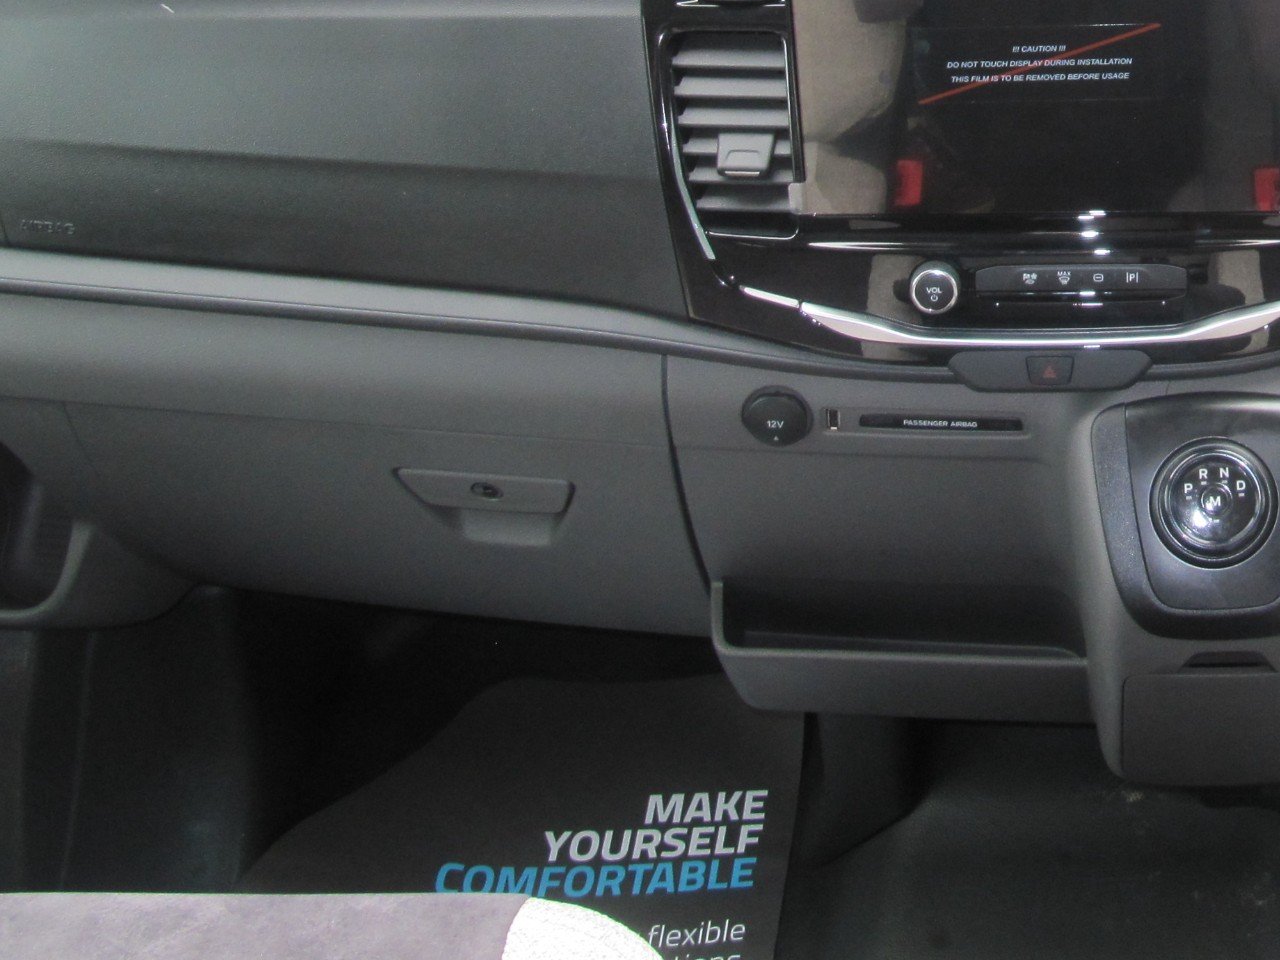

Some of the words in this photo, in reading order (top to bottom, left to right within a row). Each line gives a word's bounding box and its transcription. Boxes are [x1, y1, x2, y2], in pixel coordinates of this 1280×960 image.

[1021, 45, 1057, 53] CAUTION
[947, 61, 960, 69] DO
[980, 60, 1008, 68] TOUCH
[1010, 59, 1043, 67] DISPLAY
[1044, 59, 1076, 67] DURING
[1077, 58, 1133, 66] INSTALLATION
[951, 75, 969, 83] THIS
[971, 75, 990, 83] FILM
[1013, 74, 1024, 82] BE
[1067, 73, 1100, 81] BEFORE
[1102, 72, 1130, 80] USAGE
[926, 286, 942, 294] VOL
[766, 419, 784, 428] 12V
[903, 419, 948, 427] PASSENGER
[950, 420, 978, 428] AIRBAG
[1184, 483, 1193, 494] P
[1199, 468, 1208, 479] R
[1219, 467, 1230, 478] N
[1236, 480, 1246, 491] D
[1209, 496, 1221, 507] M
[644, 790, 769, 825] MAKE
[544, 824, 763, 862] YOURSELF
[434, 857, 757, 898] COMFORTABLE
[648, 919, 746, 948] flexible
